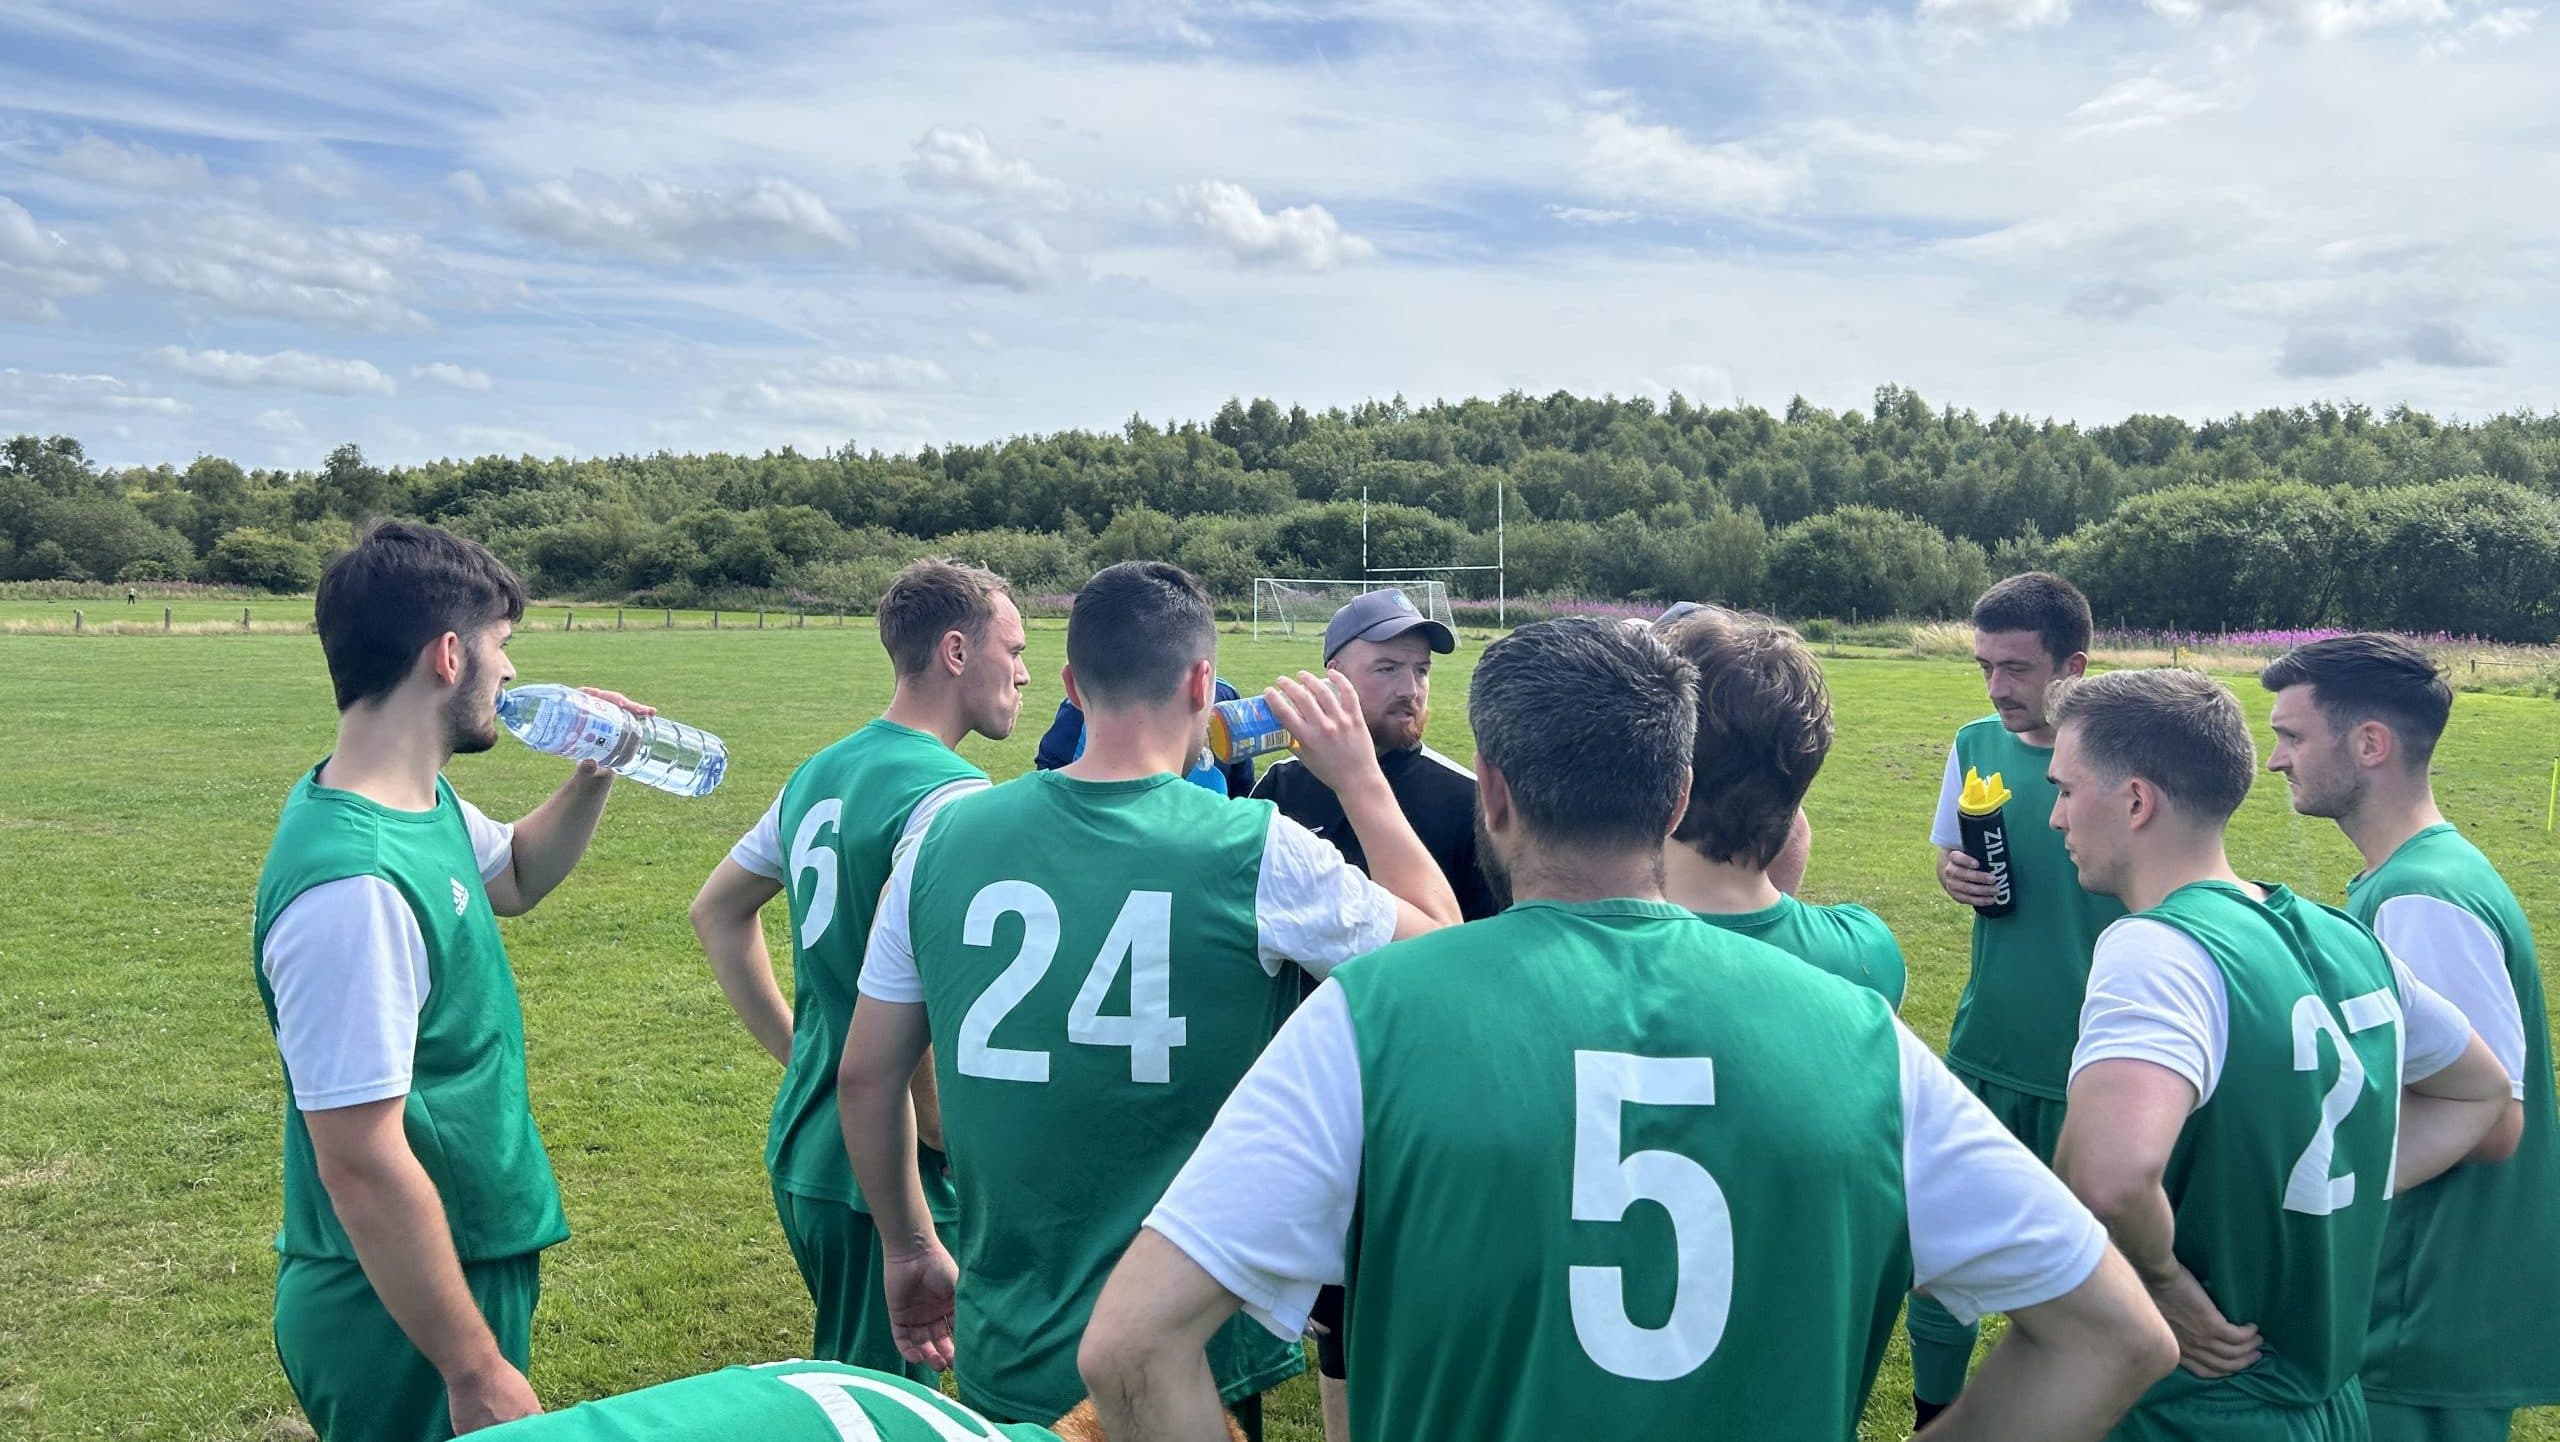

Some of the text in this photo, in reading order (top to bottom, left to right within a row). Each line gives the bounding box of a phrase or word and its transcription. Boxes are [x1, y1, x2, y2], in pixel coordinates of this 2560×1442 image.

[789, 798, 843, 950] 6
[1983, 826, 2011, 906] ZILAND
[957, 879, 1187, 1083] 24
[2282, 987, 2406, 1216] 27
[1569, 1049, 1734, 1381] 5
